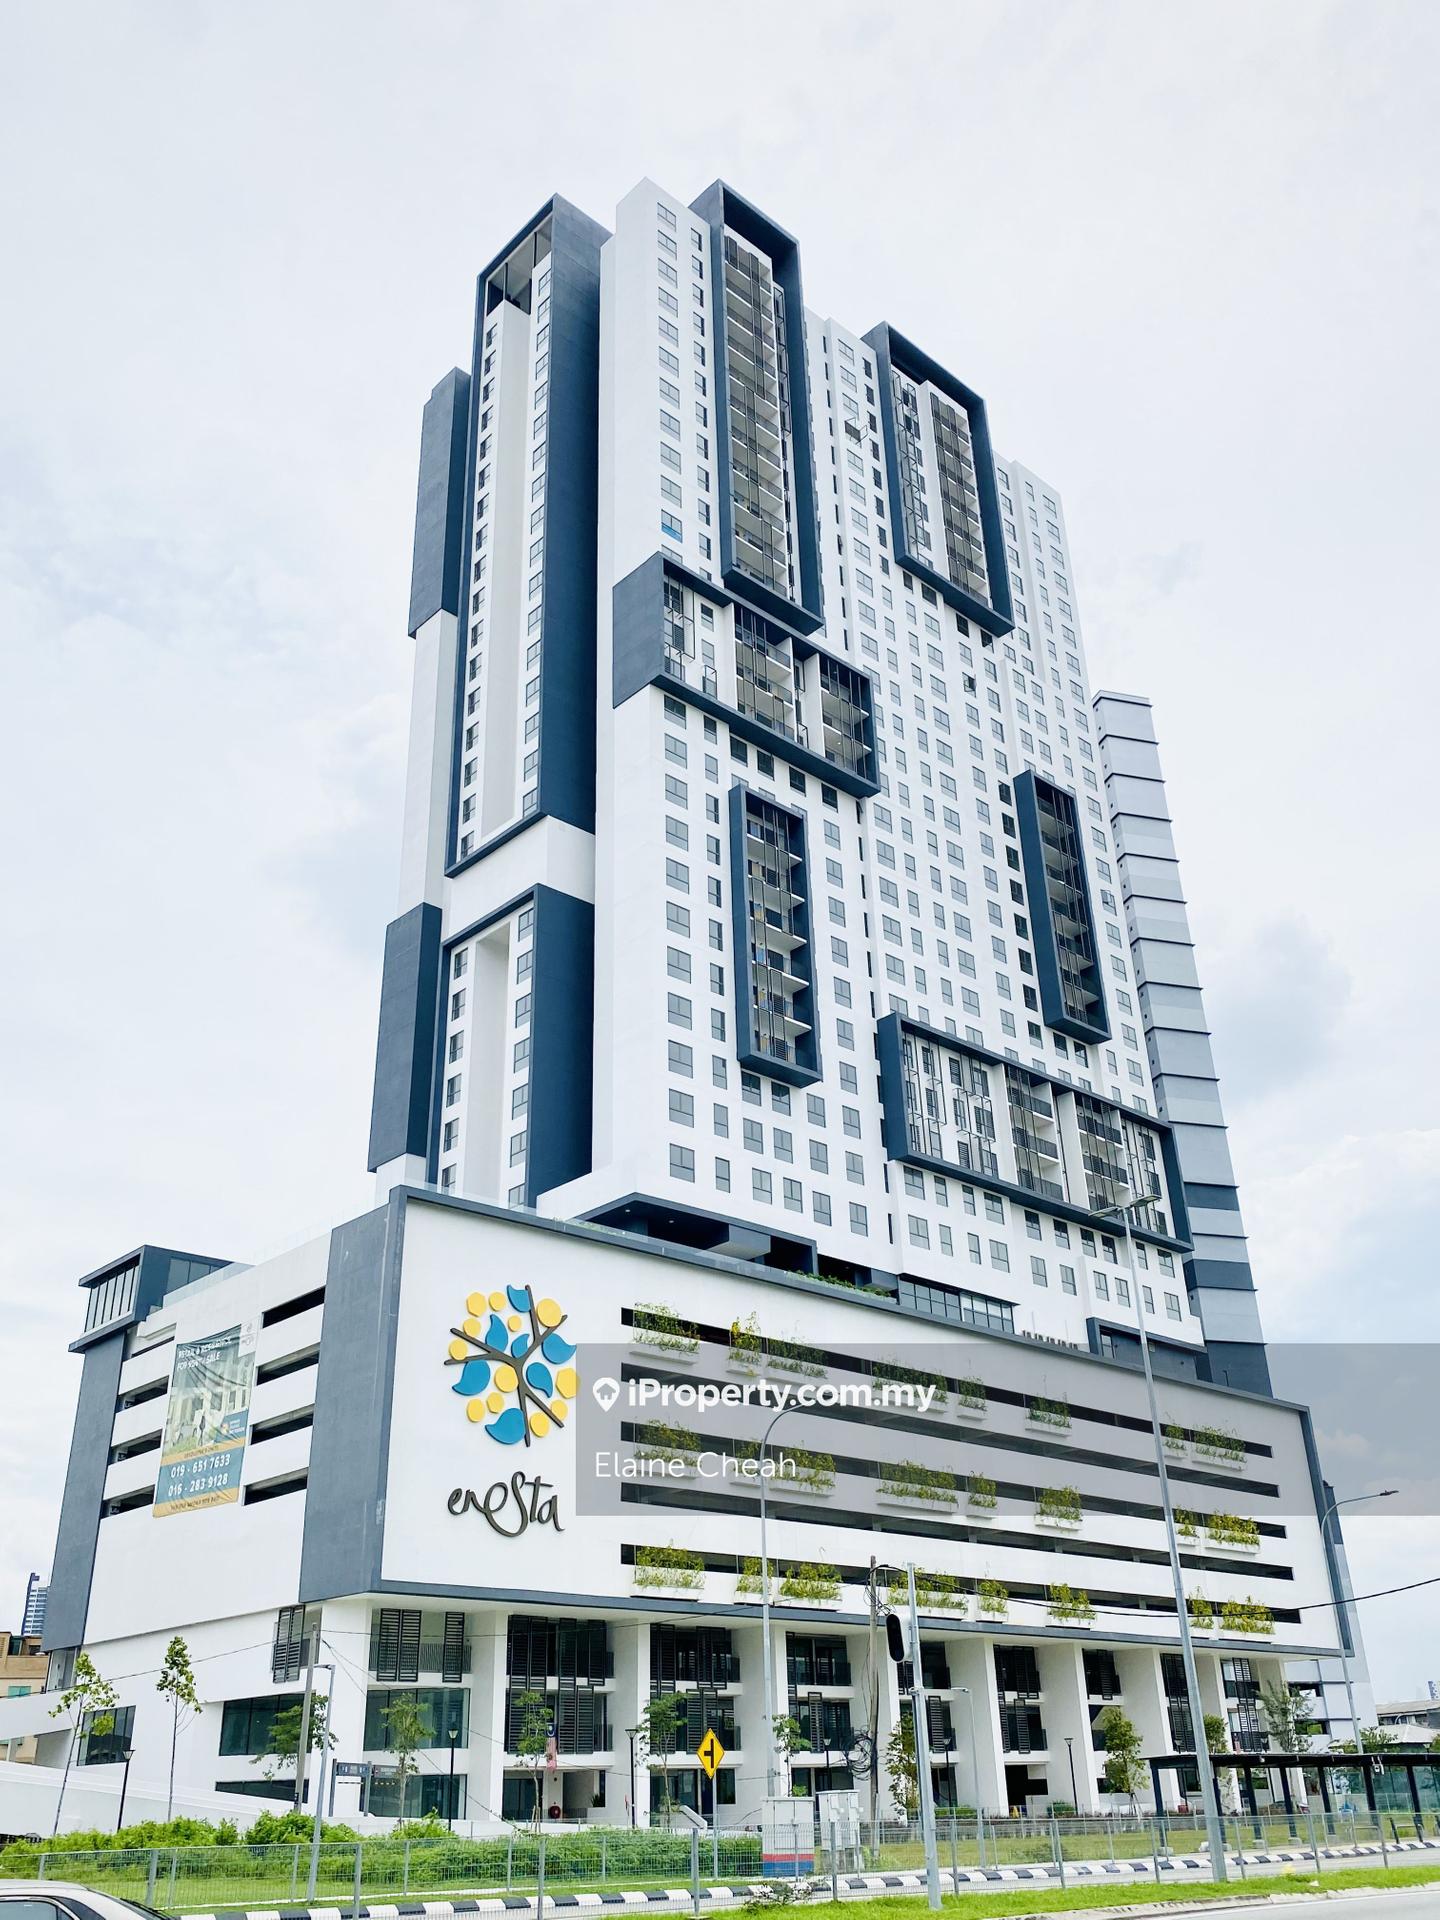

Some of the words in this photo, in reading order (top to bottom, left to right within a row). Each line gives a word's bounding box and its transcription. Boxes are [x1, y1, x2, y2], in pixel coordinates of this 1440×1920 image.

[171, 1464, 185, 1478] 019
[192, 1459, 208, 1473] 651
[209, 1453, 231, 1469] 7633
[168, 1483, 182, 1497] 016
[190, 1478, 205, 1493] 283
[207, 1473, 229, 1488] 9128
